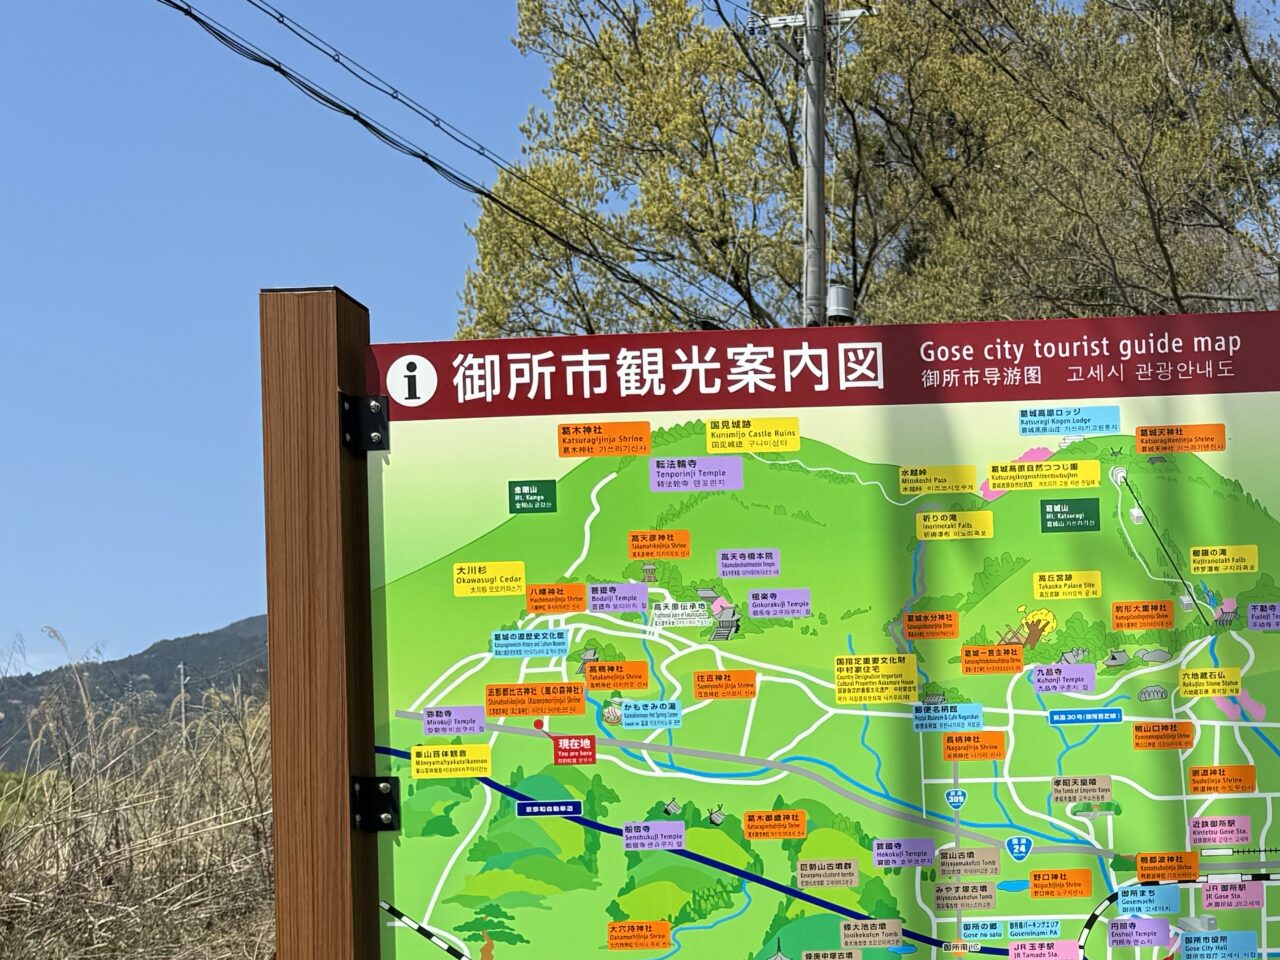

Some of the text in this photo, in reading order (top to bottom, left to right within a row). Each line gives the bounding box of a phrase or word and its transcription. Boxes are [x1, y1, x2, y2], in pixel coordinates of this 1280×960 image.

[920, 332, 1241, 364] Gose city tourist guide map
[452, 341, 884, 403] 御所市観光案内図
[1066, 360, 1235, 383] 고세시 관광안내도
[921, 365, 1042, 389] 御所市导游图
[710, 420, 751, 430] 国見城跡
[1051, 416, 1092, 426] Kogen Lodge
[748, 429, 796, 438] Castle Ruins
[618, 434, 644, 443] Shrine
[698, 468, 726, 478] Temple
[456, 566, 487, 575] 大川杉
[456, 575, 522, 586] Okawasugi Cedar
[1063, 582, 1082, 590] Palace
[615, 594, 637, 602] Temple
[786, 600, 809, 608] Temple
[1251, 612, 1271, 621] Fudoji
[1062, 676, 1084, 684] Temple
[1205, 679, 1221, 687] Stone
[453, 717, 476, 726] Temple
[558, 738, 591, 749] 現在地
[1192, 776, 1221, 785] Sudojinja
[1219, 827, 1235, 835] Gose
[1236, 827, 1248, 835] Sta.
[625, 832, 683, 841] Senshukuji Temple
[1013, 845, 1026, 853] 24
[905, 850, 927, 858] Temple
[1206, 883, 1247, 892] JR 御所駅
[1214, 892, 1230, 900] Gose
[1121, 897, 1155, 905] Gosemachi
[881, 930, 899, 938] Tomb
[963, 930, 979, 938] Gose
[987, 930, 1003, 938] sato
[1135, 930, 1157, 938] Temple
[1014, 942, 1054, 951] JR 玉手駅
[1185, 943, 1228, 952] Gose City Hall
